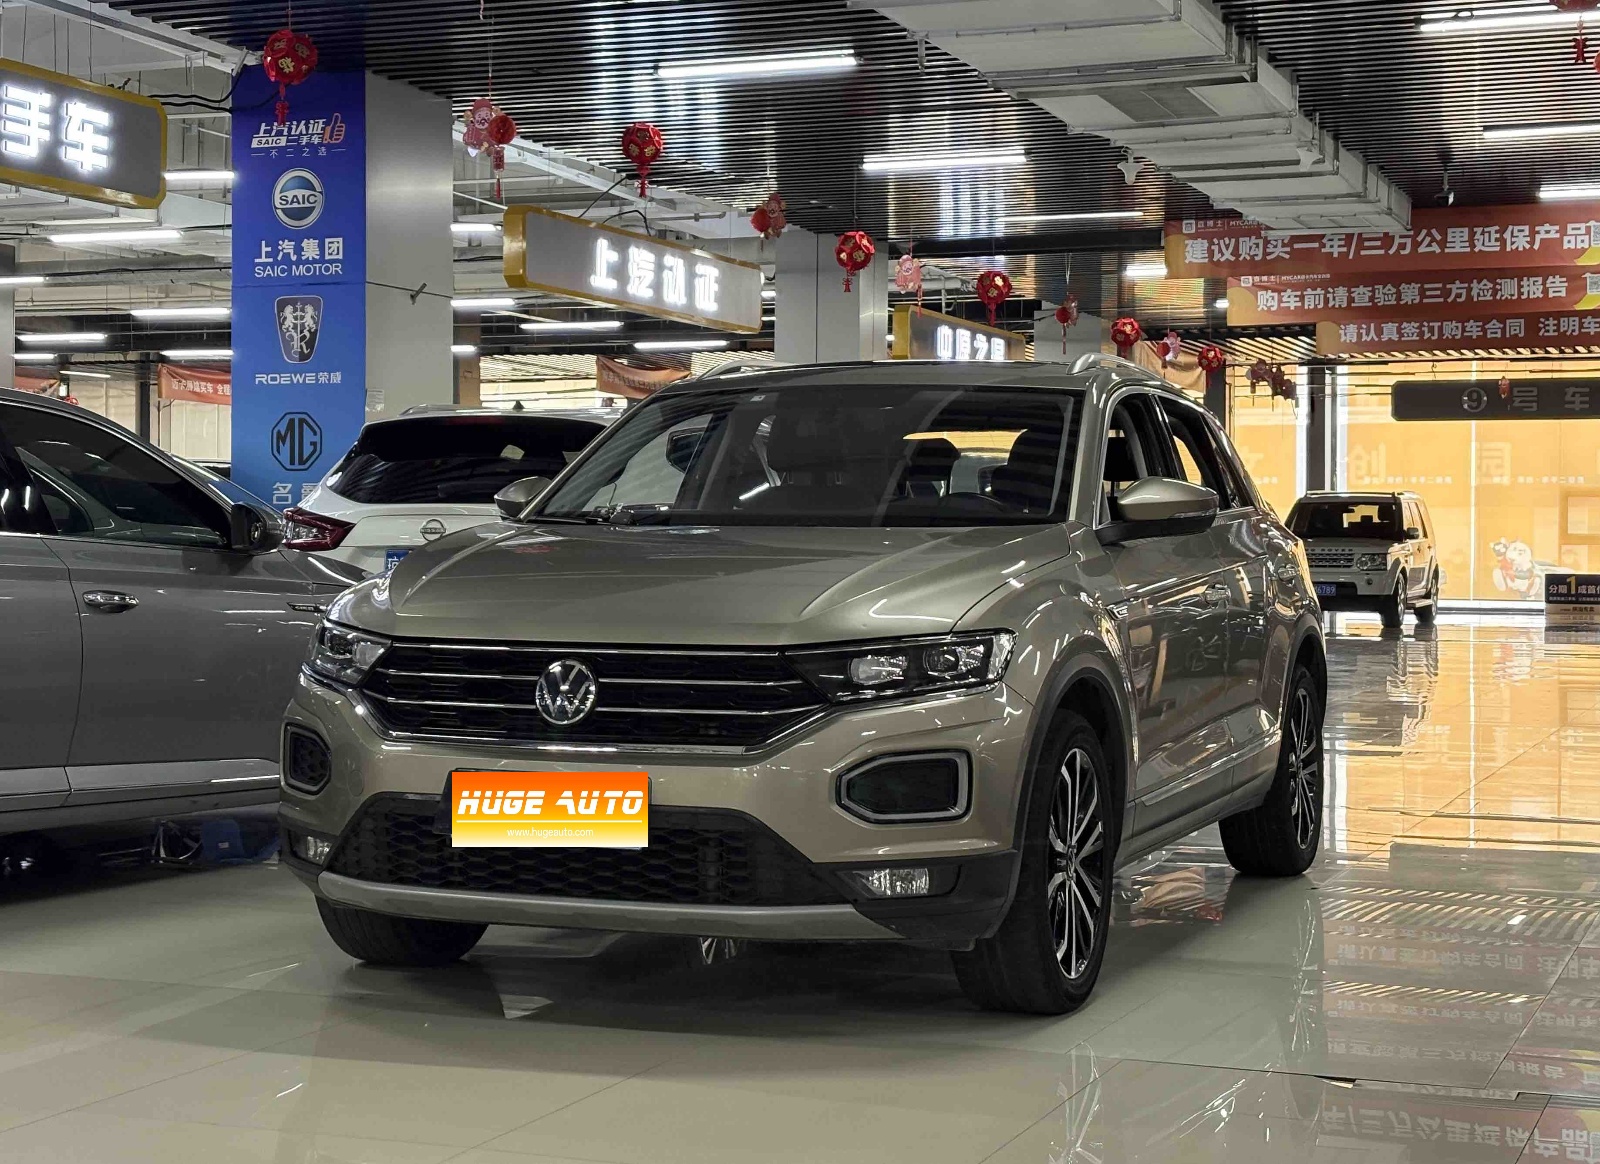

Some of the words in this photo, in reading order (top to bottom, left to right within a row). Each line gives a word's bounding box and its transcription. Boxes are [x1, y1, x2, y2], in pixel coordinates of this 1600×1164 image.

[253, 119, 326, 137] 上汽认证
[256, 138, 282, 146] SAIC
[287, 134, 323, 146] 二手车
[279, 193, 318, 206] SAIC
[254, 237, 343, 263] 上汽集团
[254, 264, 288, 278] SAIC
[292, 263, 343, 276] MOTOR
[590, 237, 719, 311] 上汽认证
[1256, 274, 1569, 312] 购车前请查验第三方检测报告
[1338, 317, 1525, 343] 请认真签订购车合同
[255, 373, 316, 385] ROEWE
[317, 371, 342, 384] 荣威
[276, 417, 318, 466] MG
